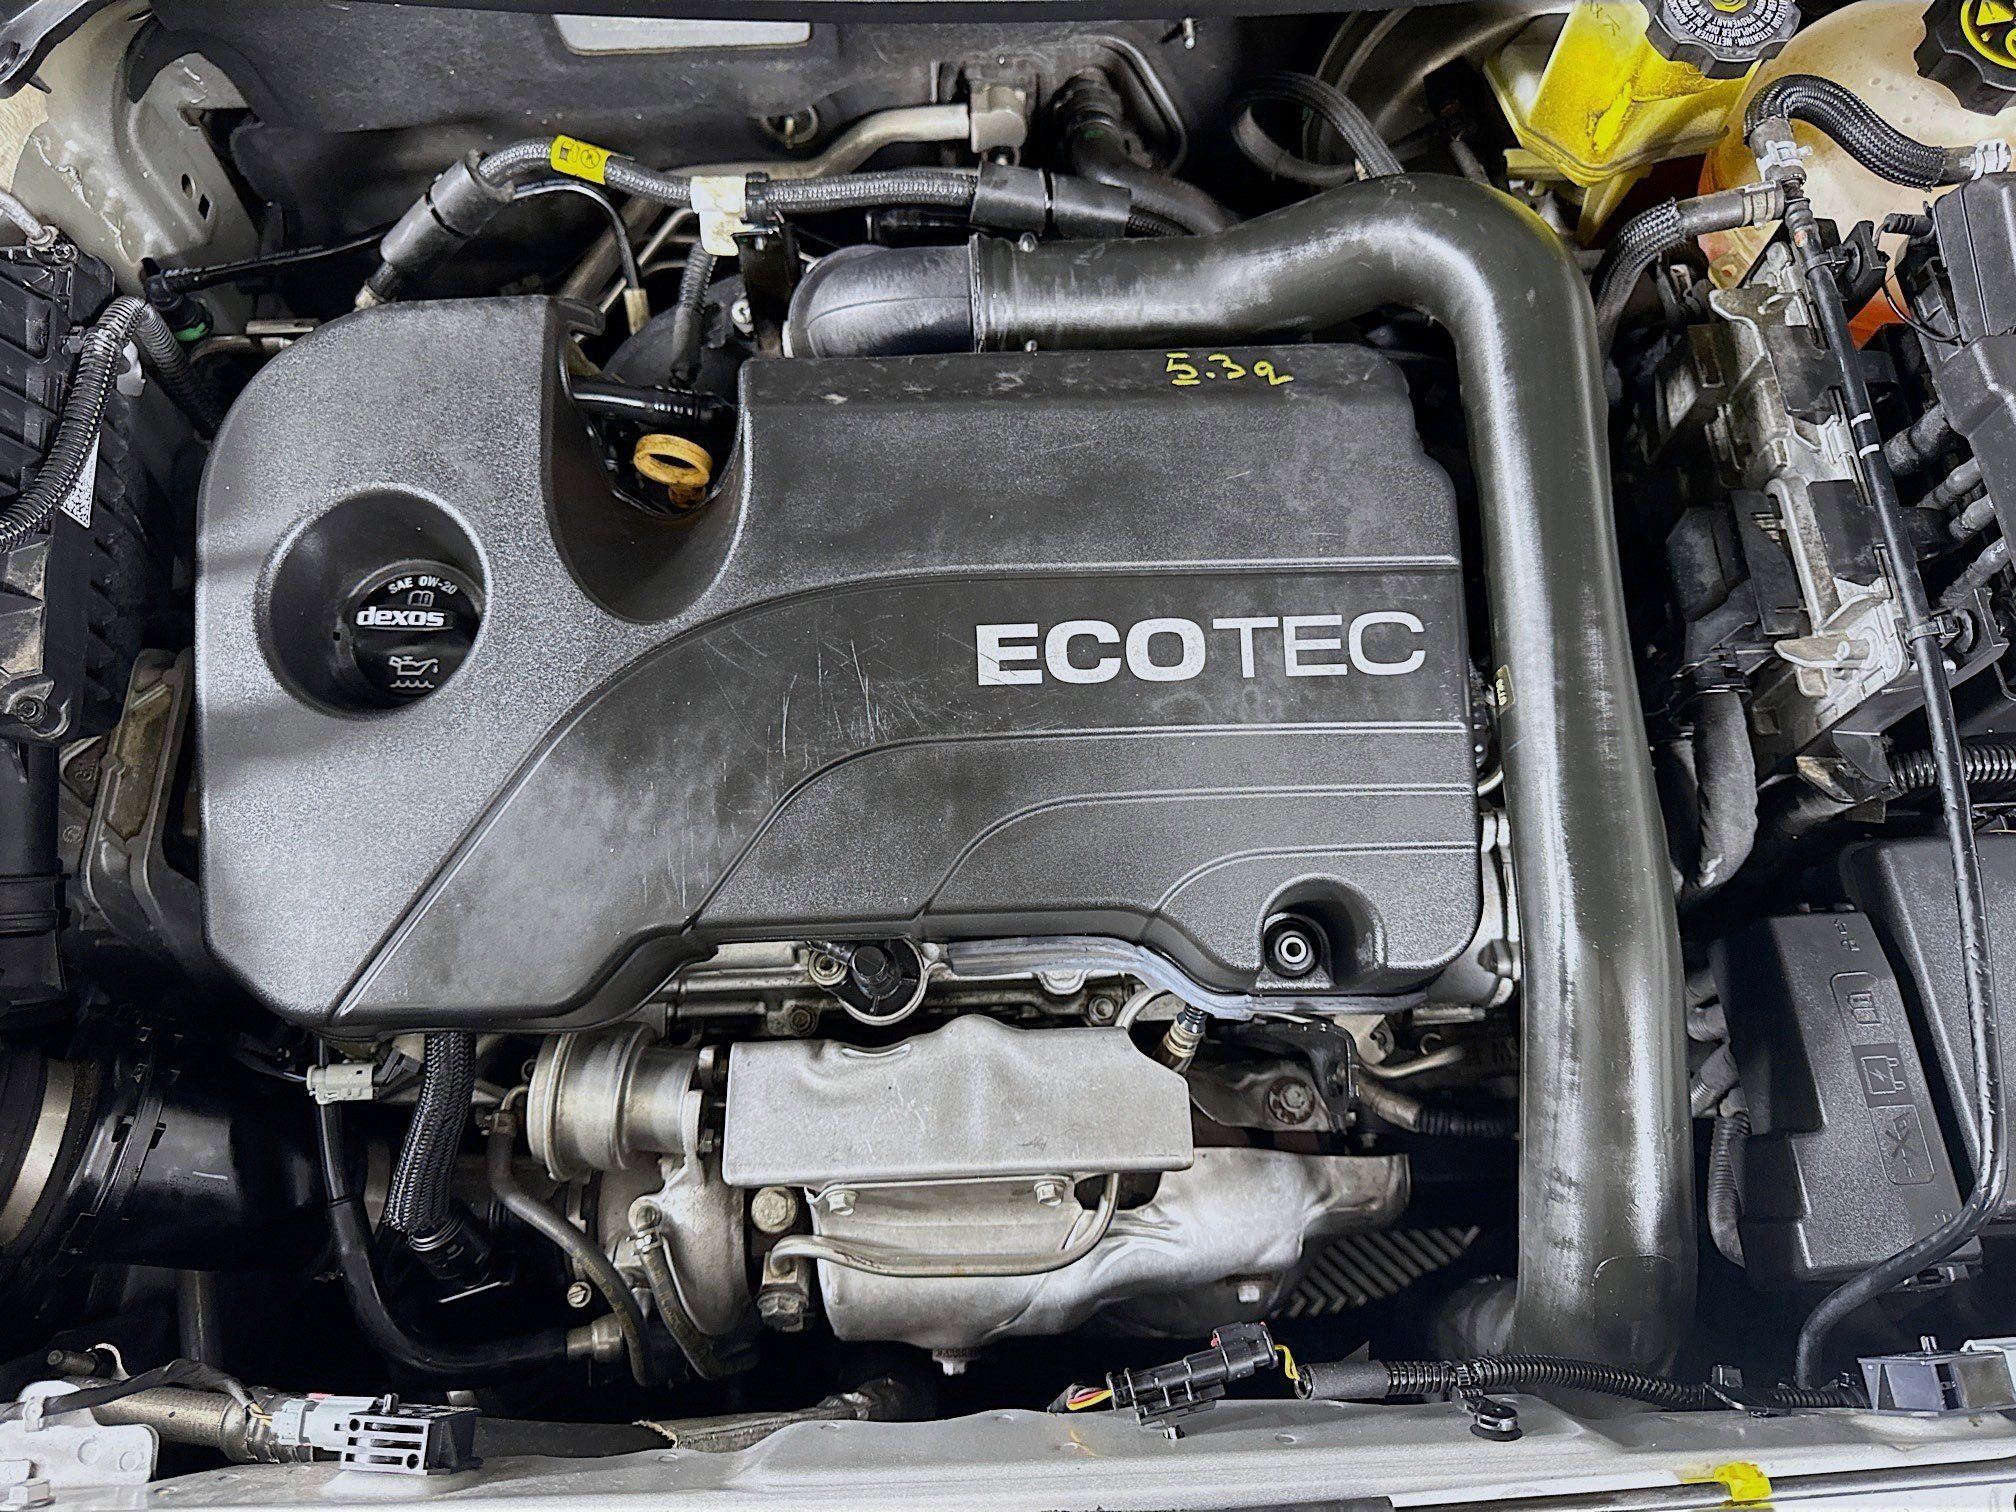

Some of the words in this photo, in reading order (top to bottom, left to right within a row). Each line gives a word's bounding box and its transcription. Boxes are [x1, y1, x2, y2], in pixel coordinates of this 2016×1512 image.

[1685, 21, 1697, 32] LE
[1692, 16, 1706, 27] DU
[1704, 23, 1720, 34] QUE
[1712, 14, 1756, 28] PROVENANT
[1694, 28, 1733, 47] NETTOYER
[1735, 25, 1774, 47] ATTENTION:
[388, 577, 414, 595] SAE
[418, 575, 458, 595] 0W-20
[356, 606, 445, 627] dexos
[976, 611, 1427, 686] ECOTEC
